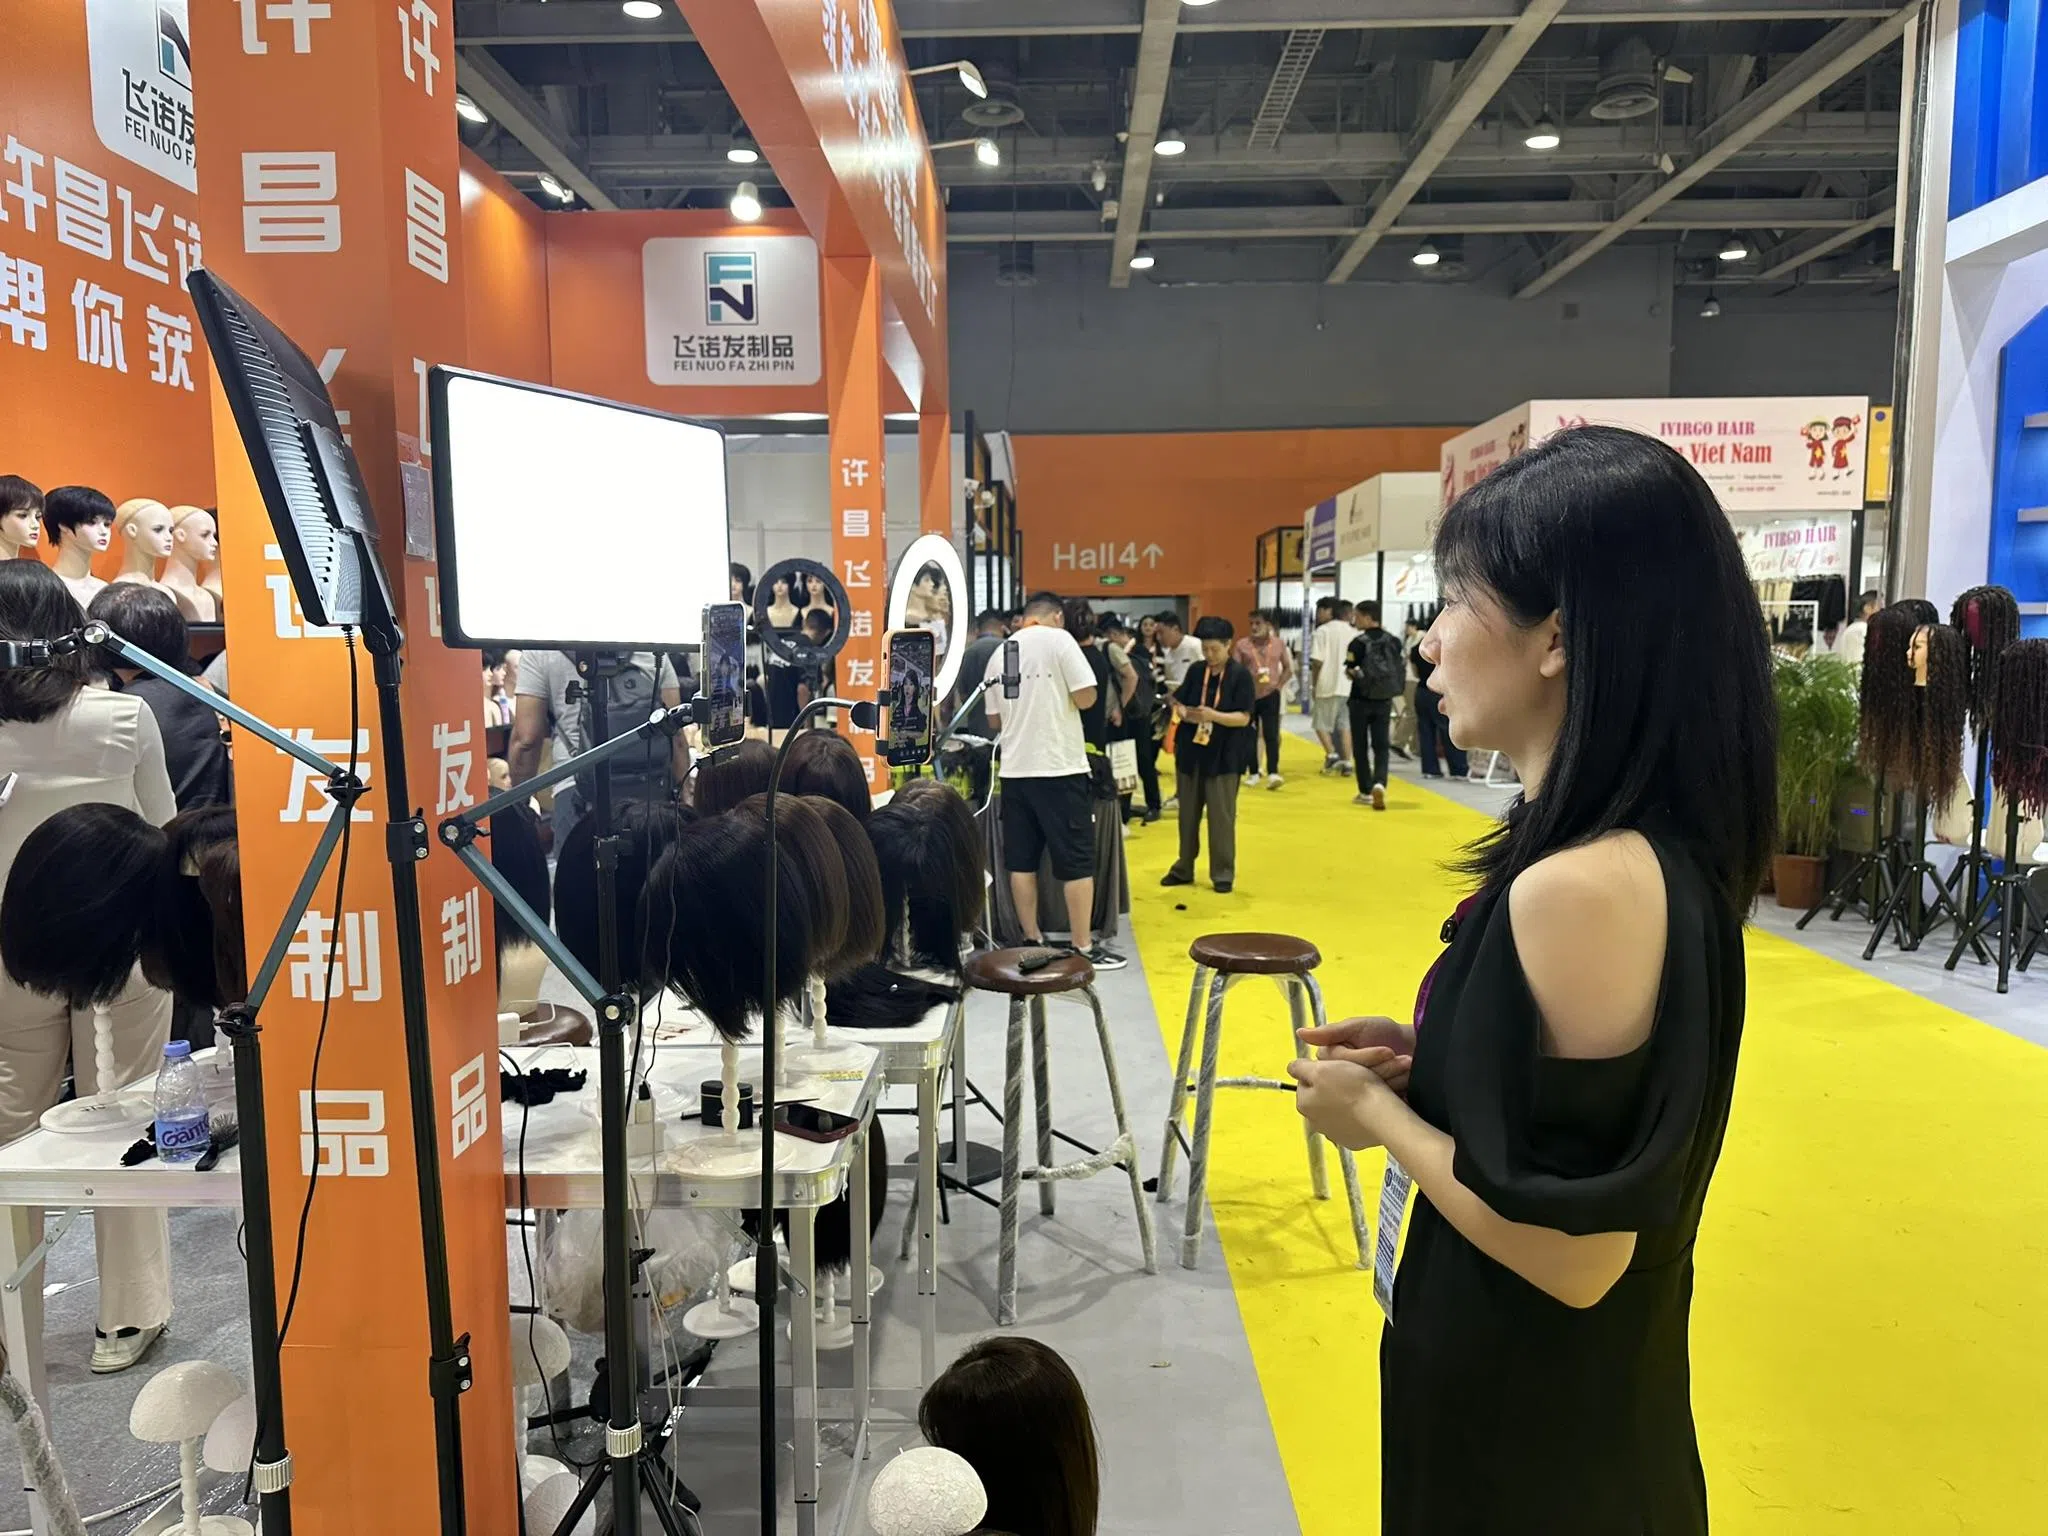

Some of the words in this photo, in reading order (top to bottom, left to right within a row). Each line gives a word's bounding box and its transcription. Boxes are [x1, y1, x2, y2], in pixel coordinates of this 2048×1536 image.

[125, 114, 147, 142] FEI
[150, 129, 182, 160] NUO
[185, 148, 197, 169] F
[674, 335, 794, 358] 飞诺发制品
[674, 361, 693, 371] FEI
[697, 361, 726, 371] NUO
[729, 361, 746, 371] FA
[749, 361, 770, 371] ZHI
[773, 361, 795, 371] PIN
[1660, 422, 1713, 437] IVIRGO
[1717, 421, 1755, 436] HAIR
[1690, 443, 1727, 464] Viet
[1731, 443, 1772, 464] Nam
[1053, 543, 1115, 570] Hall
[1118, 542, 1139, 569] 4
